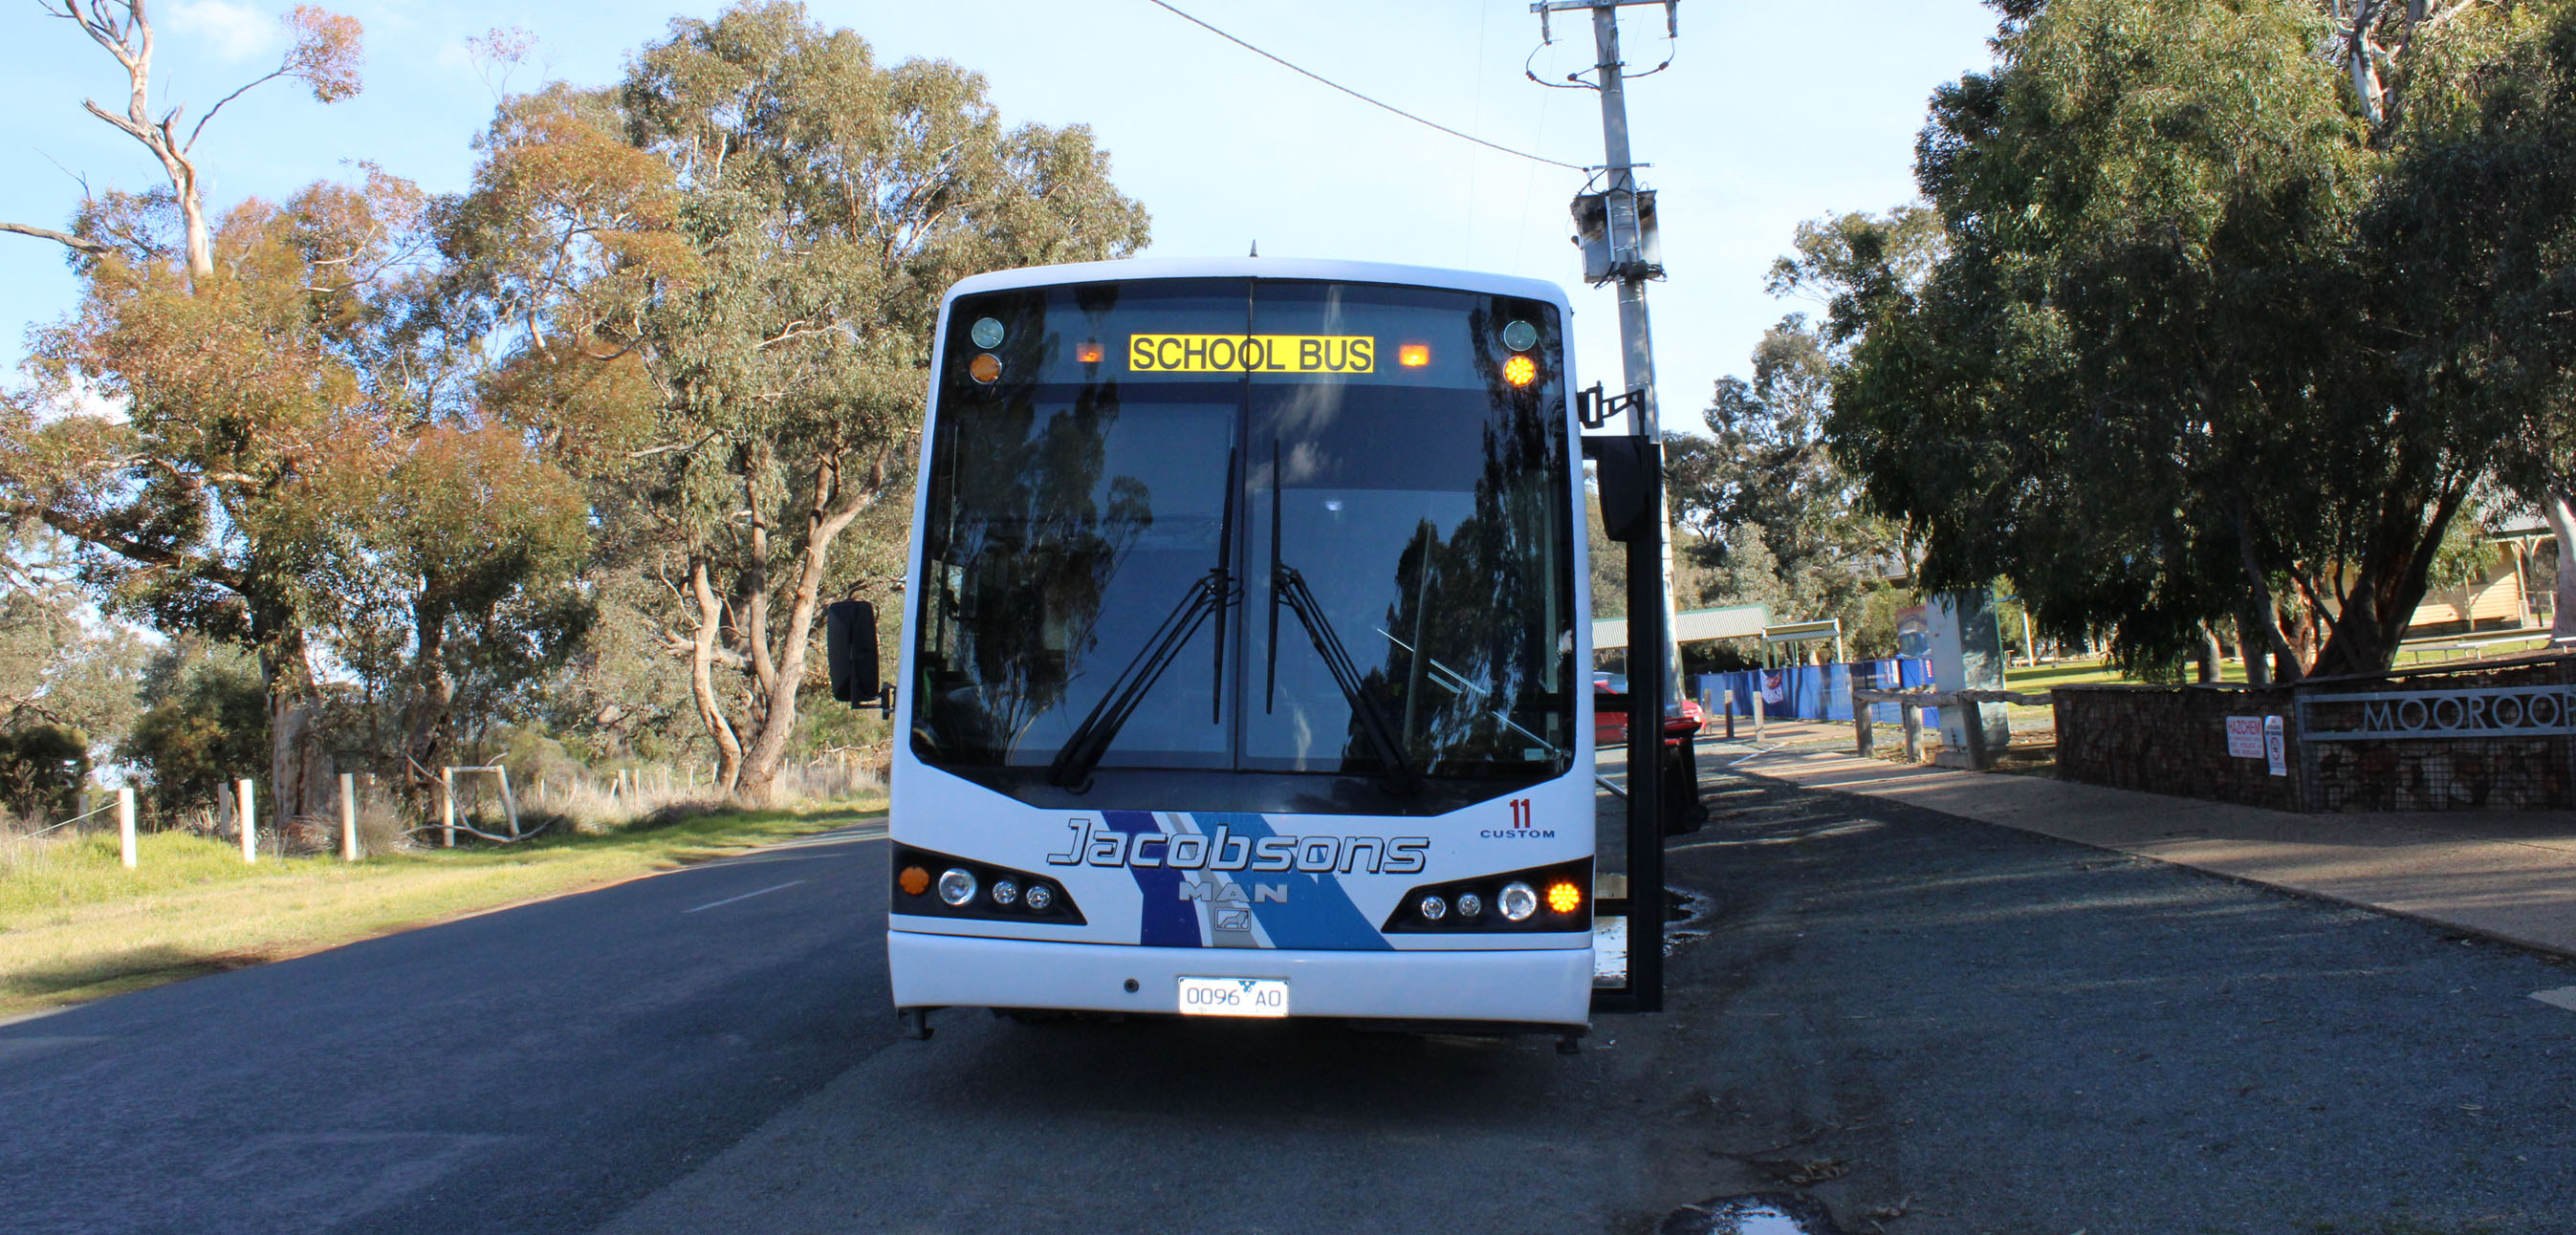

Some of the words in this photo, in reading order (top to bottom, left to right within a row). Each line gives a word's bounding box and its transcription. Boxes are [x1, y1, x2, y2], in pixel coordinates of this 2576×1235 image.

[1133, 337, 1285, 371] SCHOOL
[1299, 339, 1371, 371] BUS
[2228, 719, 2261, 734] HAZCHEM
[1509, 798, 1531, 830] 11
[1047, 817, 1430, 874] Jacobsons
[1479, 829, 1556, 839] CUSTOM
[1178, 880, 1289, 903] MAN
[1187, 986, 1240, 1007] 0096
